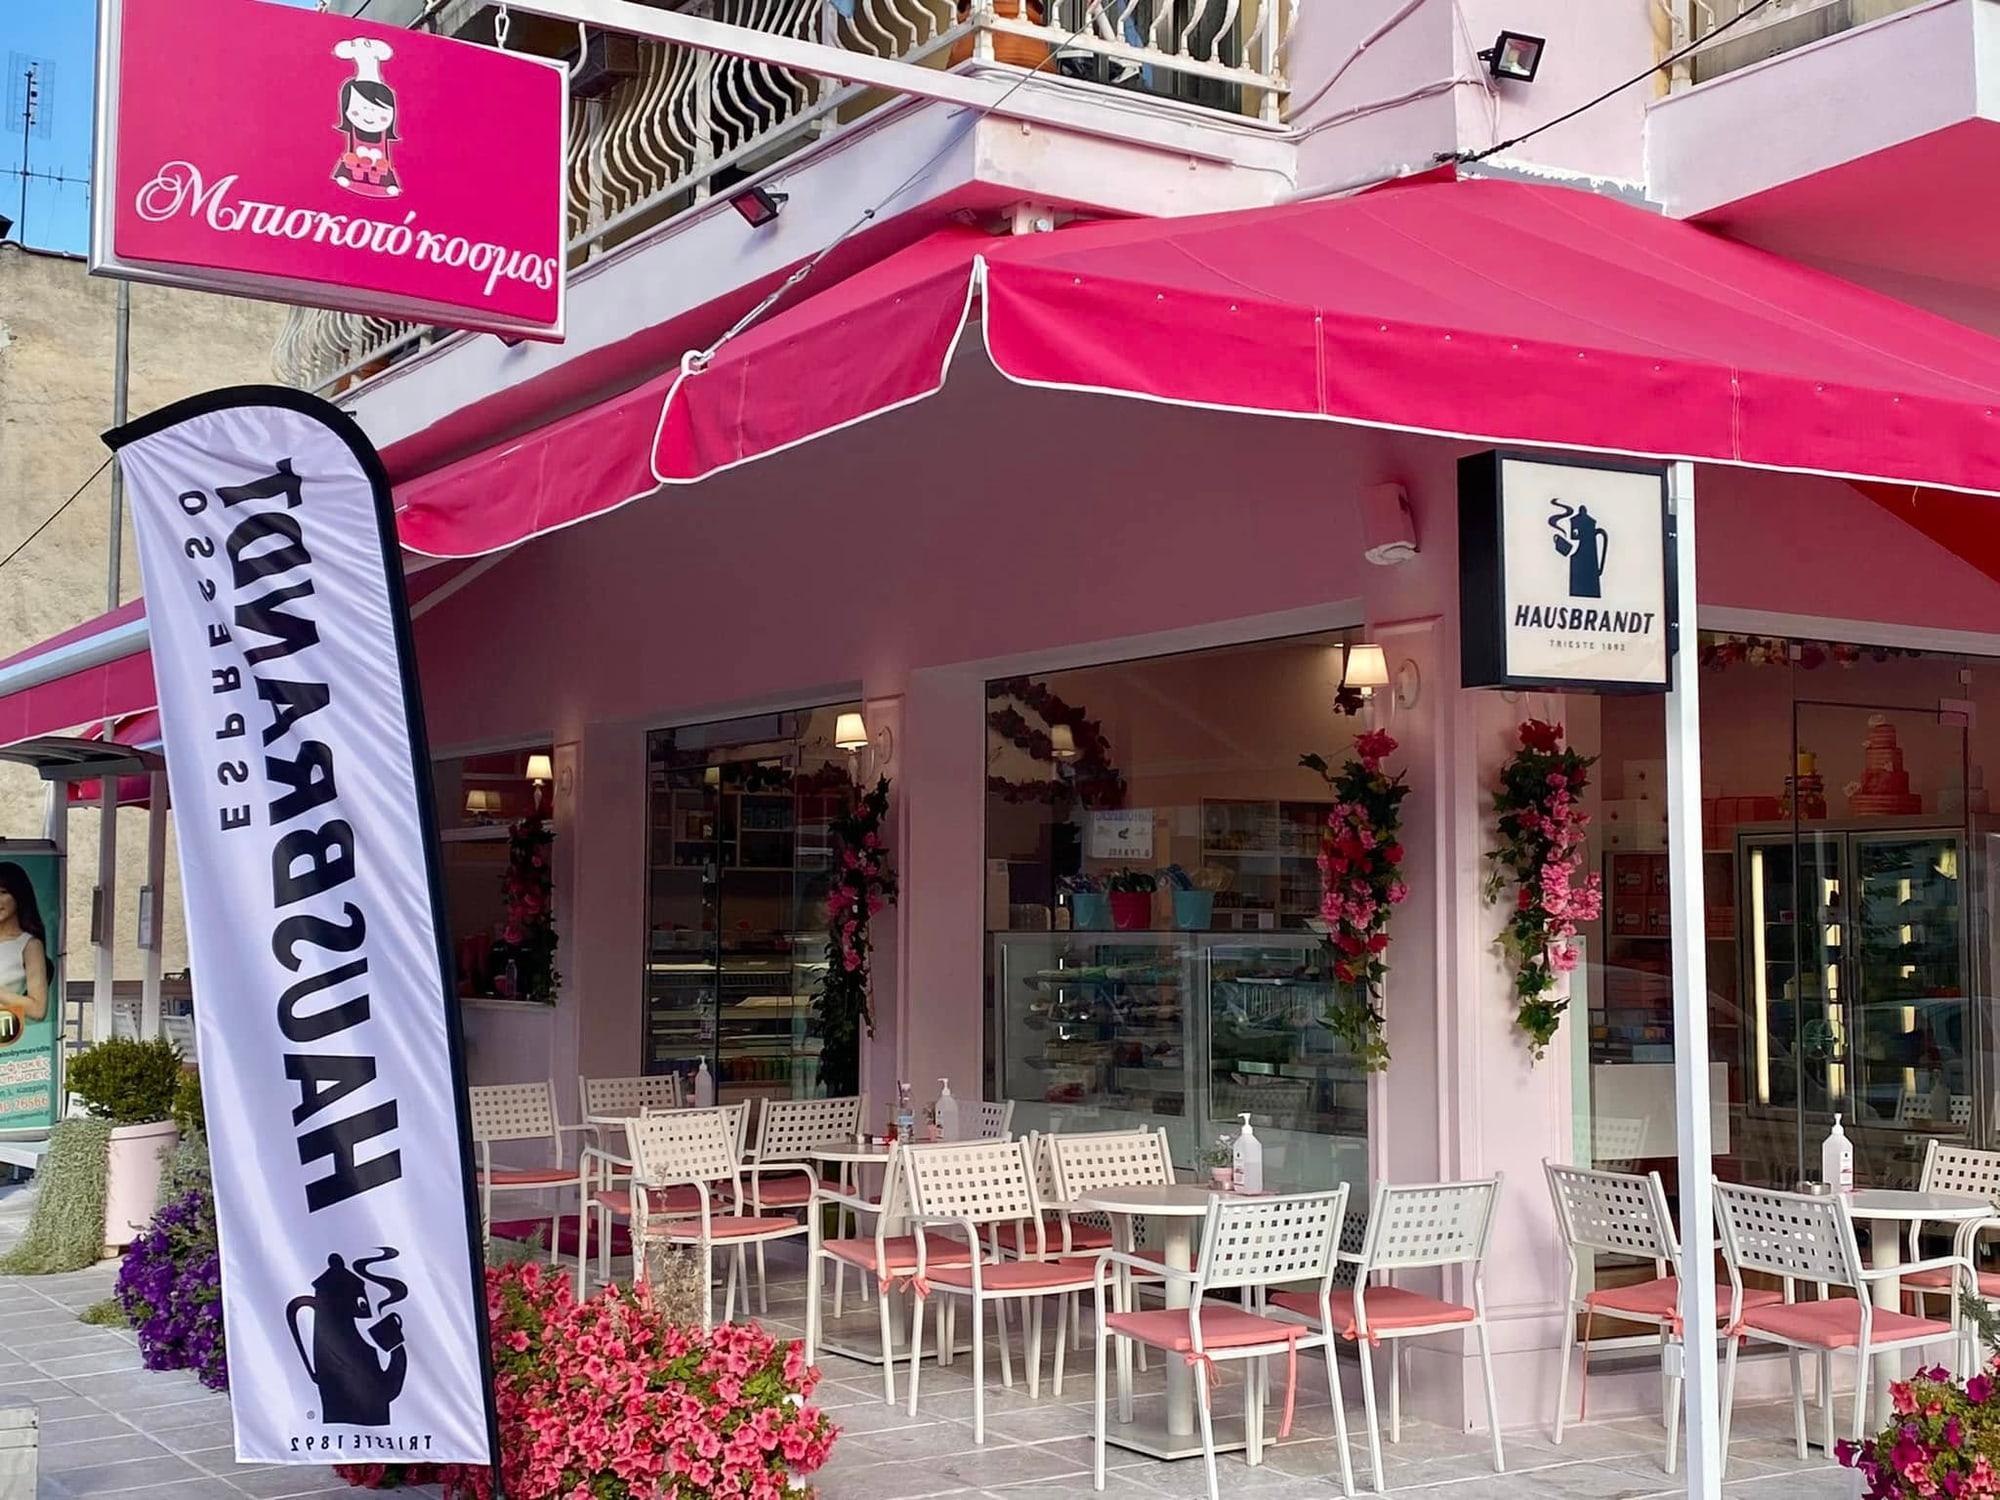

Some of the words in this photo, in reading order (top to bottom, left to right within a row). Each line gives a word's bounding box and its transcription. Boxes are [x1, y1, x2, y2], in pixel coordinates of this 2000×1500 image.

[135, 160, 557, 296] Μπισκοτόκοσμος
[1514, 604, 1655, 634] HAUSBRANDT
[1550, 639, 1594, 649] TRIESTE
[1602, 642, 1625, 651] 1892
